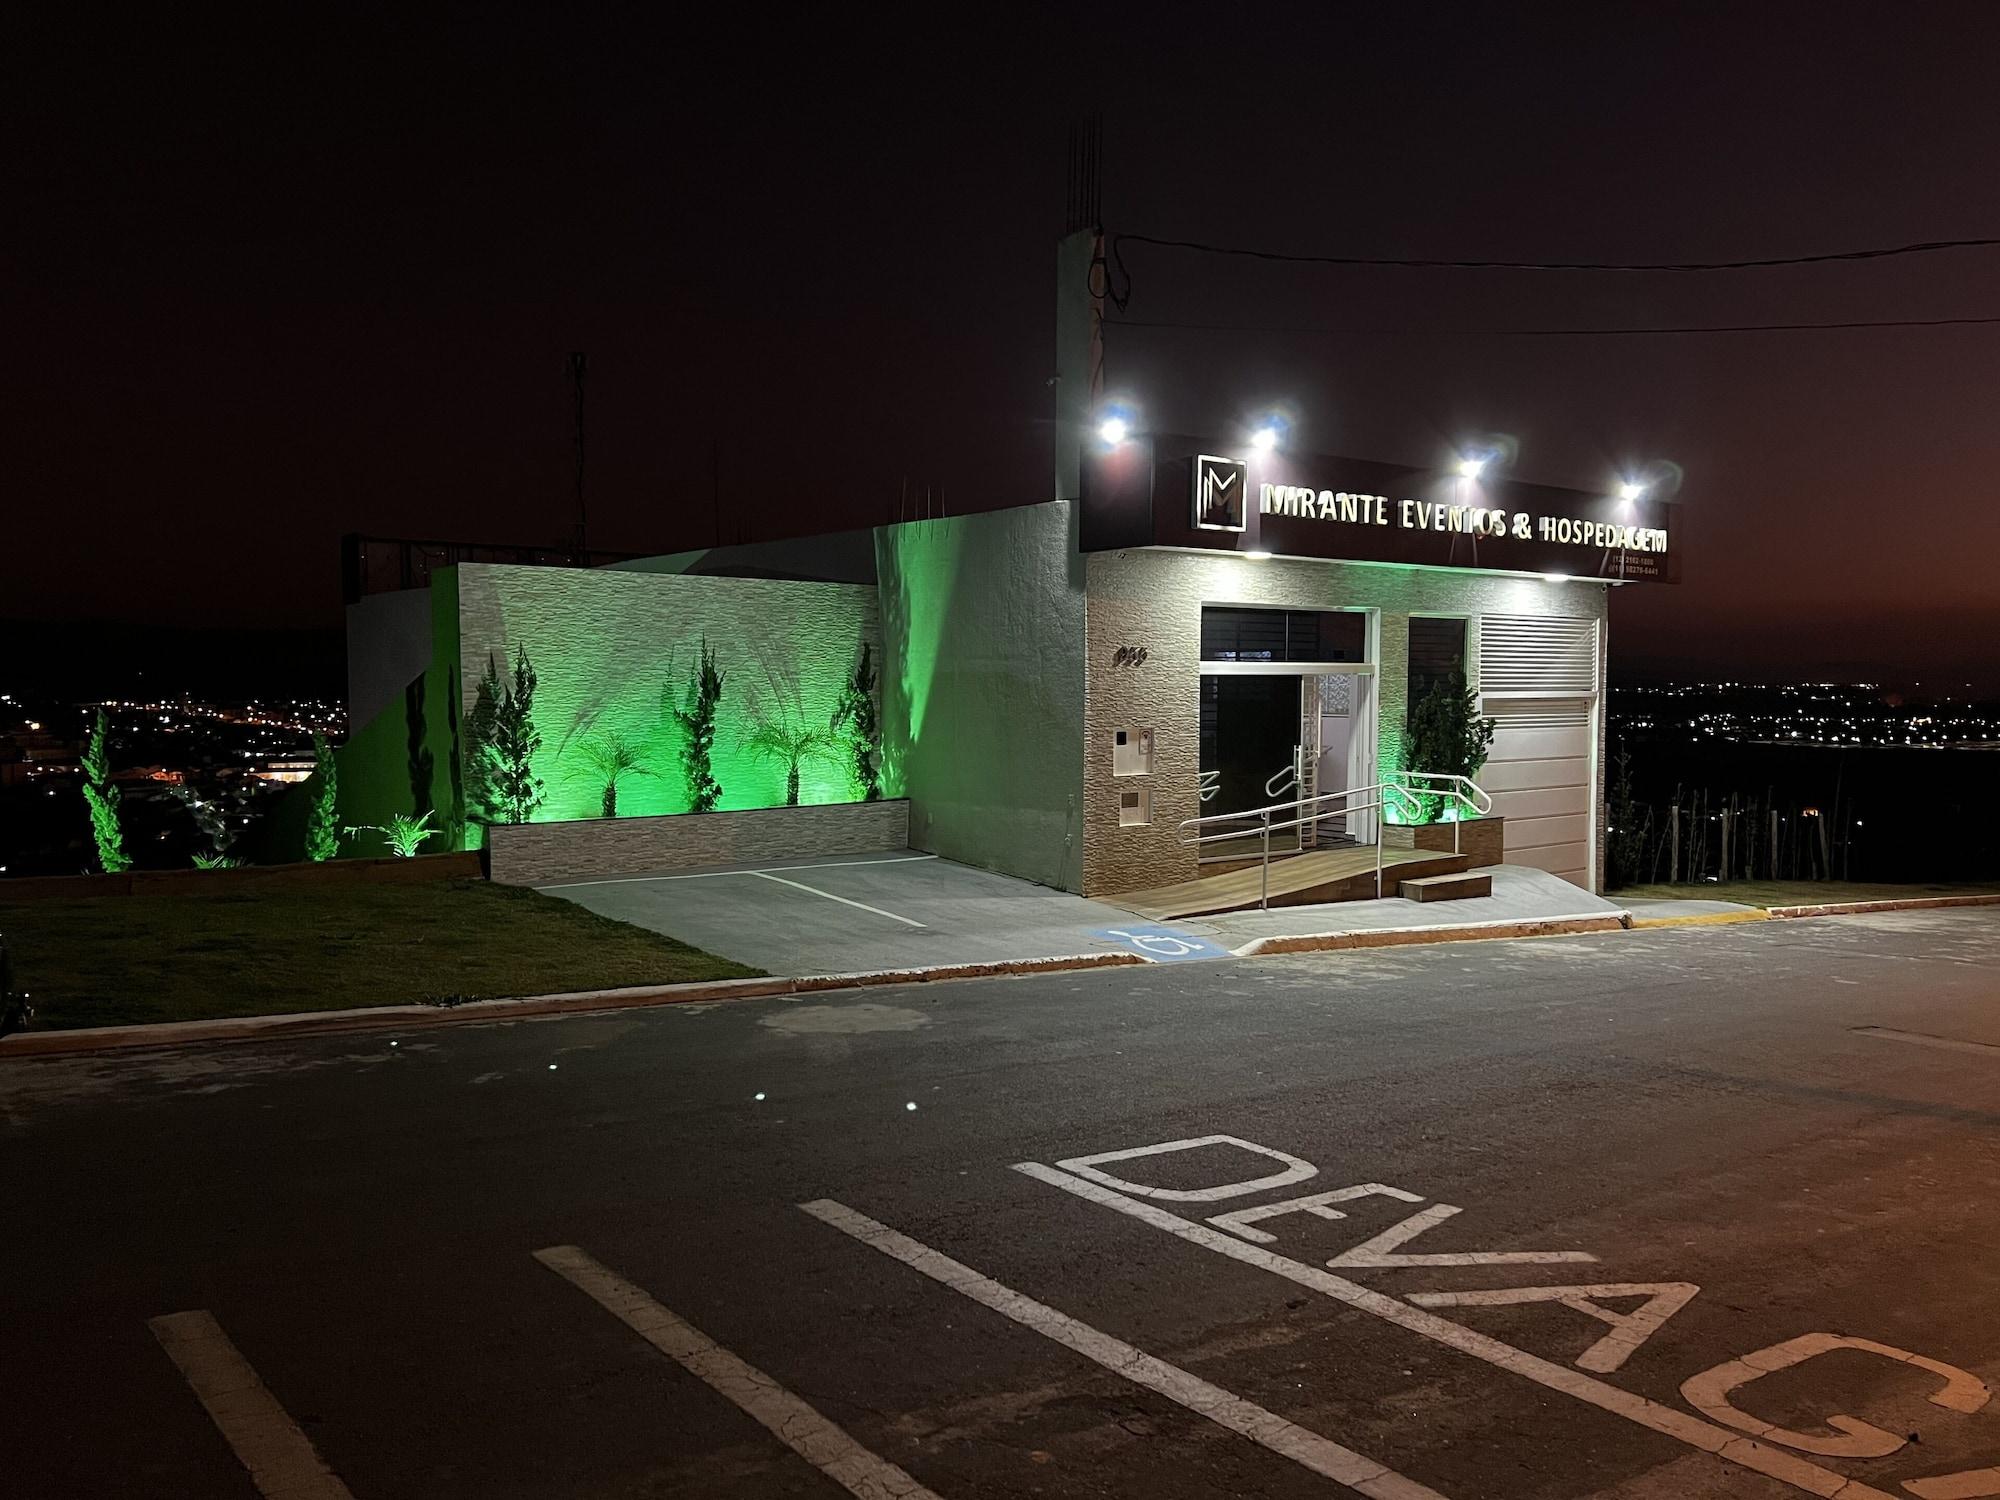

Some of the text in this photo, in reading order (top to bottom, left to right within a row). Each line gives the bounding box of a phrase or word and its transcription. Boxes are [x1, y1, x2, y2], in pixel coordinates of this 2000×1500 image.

[1260, 482, 1668, 553] MIRANTE EVENTOS & HOSPEDAGEM
[1055, 1133, 2000, 1500] DEVAG
